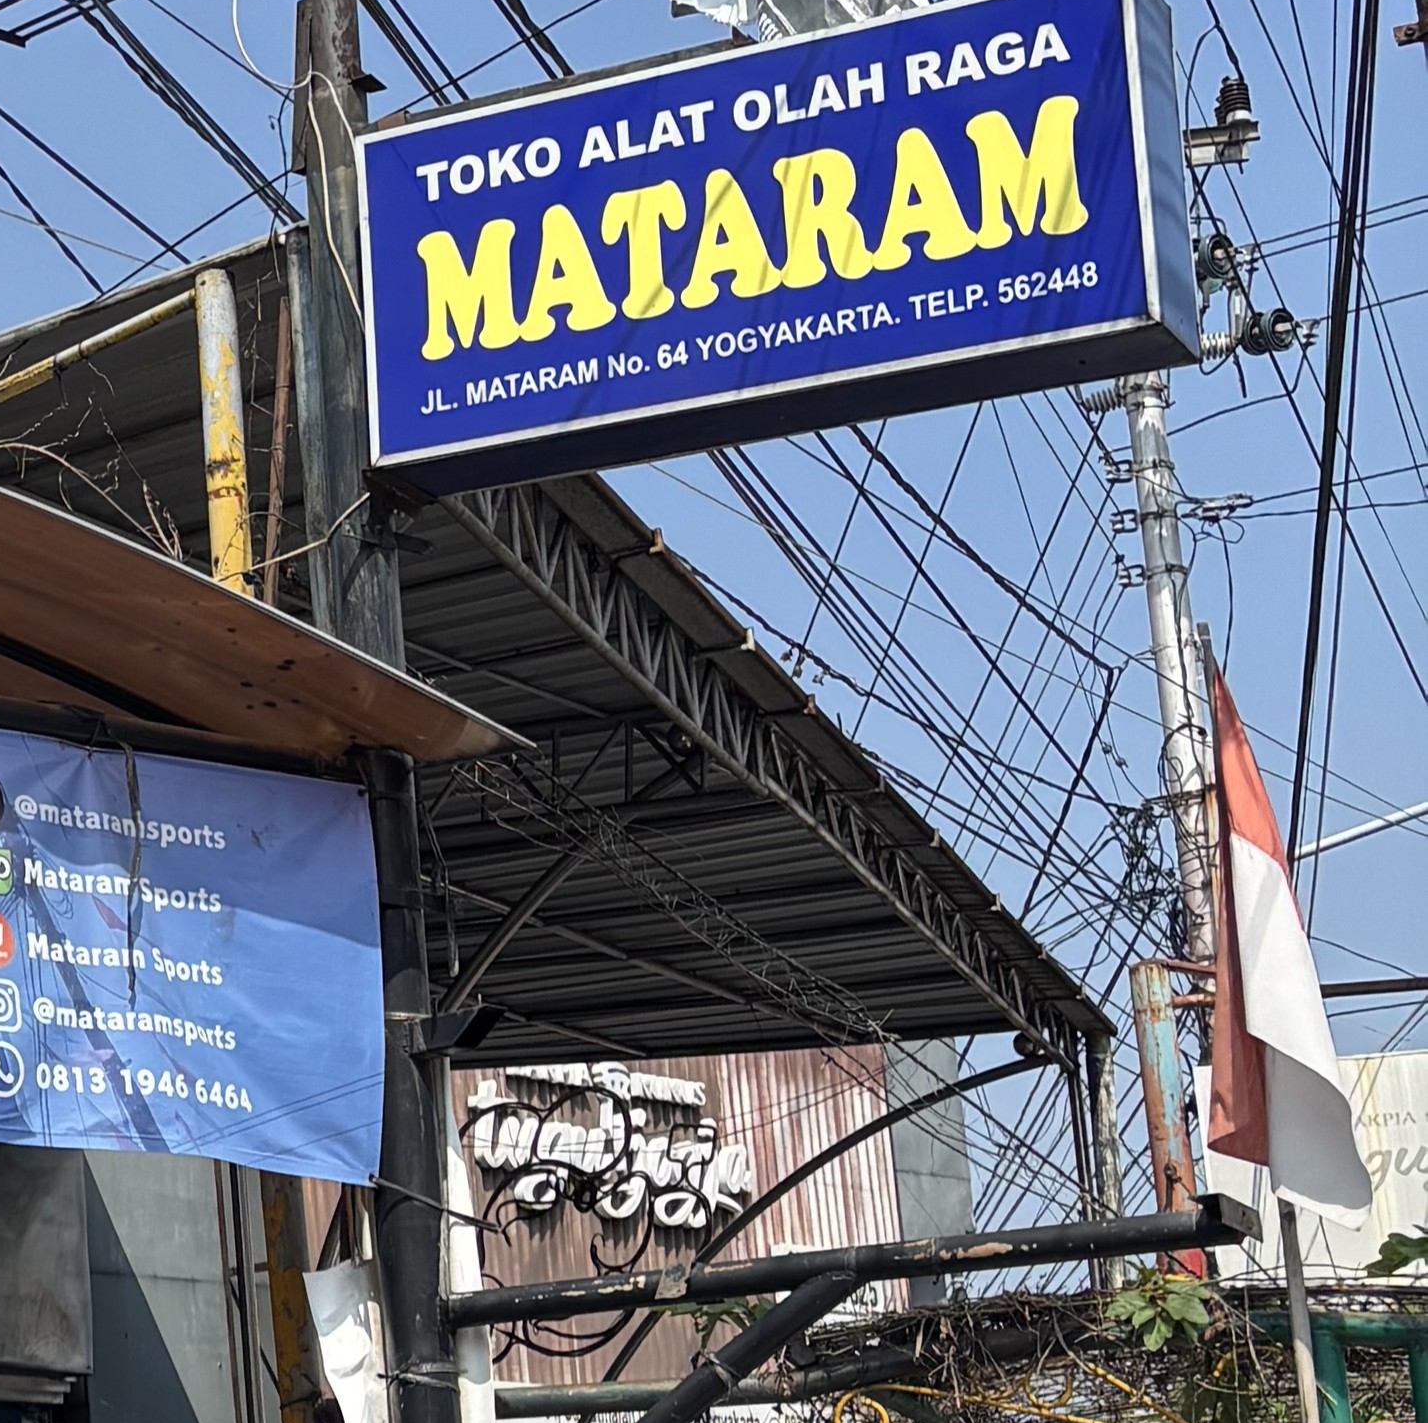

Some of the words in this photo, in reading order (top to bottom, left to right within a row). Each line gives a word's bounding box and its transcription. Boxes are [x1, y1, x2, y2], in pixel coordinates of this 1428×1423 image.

[417, 136, 562, 201] TOKO
[579, 101, 714, 170] ALAT
[733, 63, 885, 132] OLAH
[906, 23, 1071, 96] RAGA
[417, 95, 1088, 361] MATARAM
[420, 386, 458, 416] JL.
[466, 358, 598, 406] MATARAM
[607, 350, 652, 378] No.
[657, 342, 689, 369] 64
[695, 303, 901, 362] YOGYAKARTA.
[909, 283, 989, 321] TELP.
[998, 261, 1099, 304] 562448
[139, 877, 222, 912] Sports
[153, 948, 223, 986] Sports
[33, 997, 236, 1050] @mataramsports
[36, 1063, 107, 1094] 0813
[120, 1068, 189, 1098] 1946
